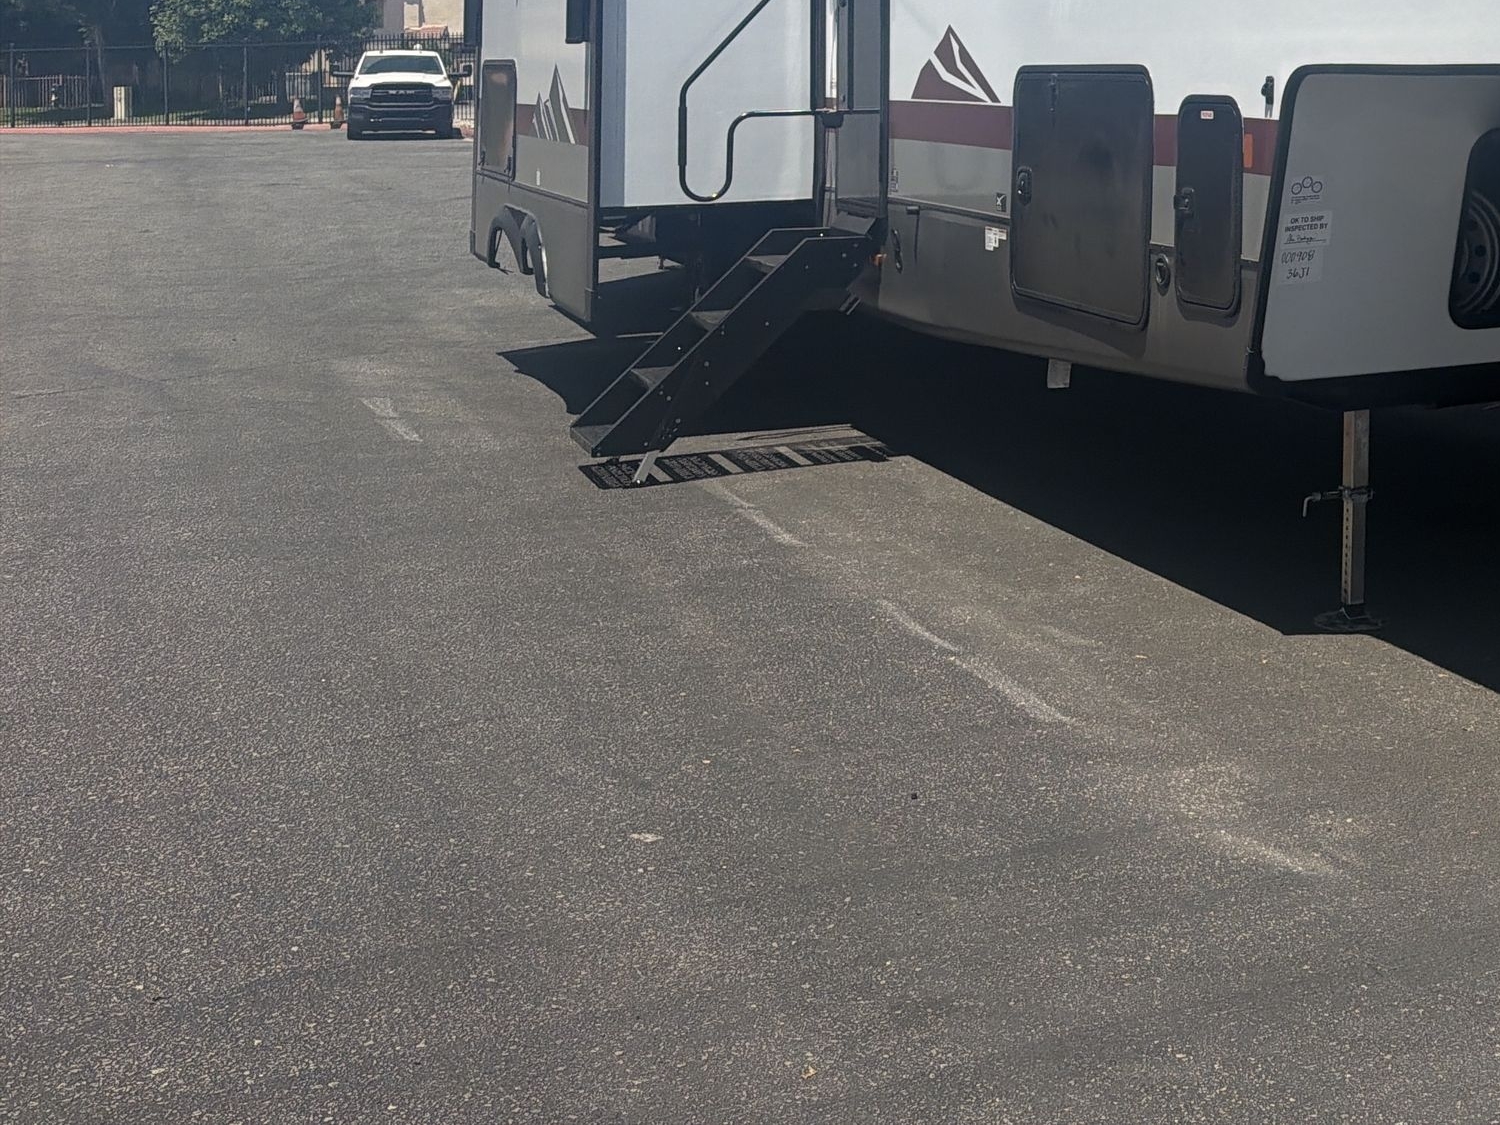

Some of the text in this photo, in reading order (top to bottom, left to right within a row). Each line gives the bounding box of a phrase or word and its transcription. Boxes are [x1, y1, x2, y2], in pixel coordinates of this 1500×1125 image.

[1290, 217, 1299, 225] OK
[1310, 215, 1324, 223] SHIP
[1285, 222, 1328, 232] INSPECTED BY
